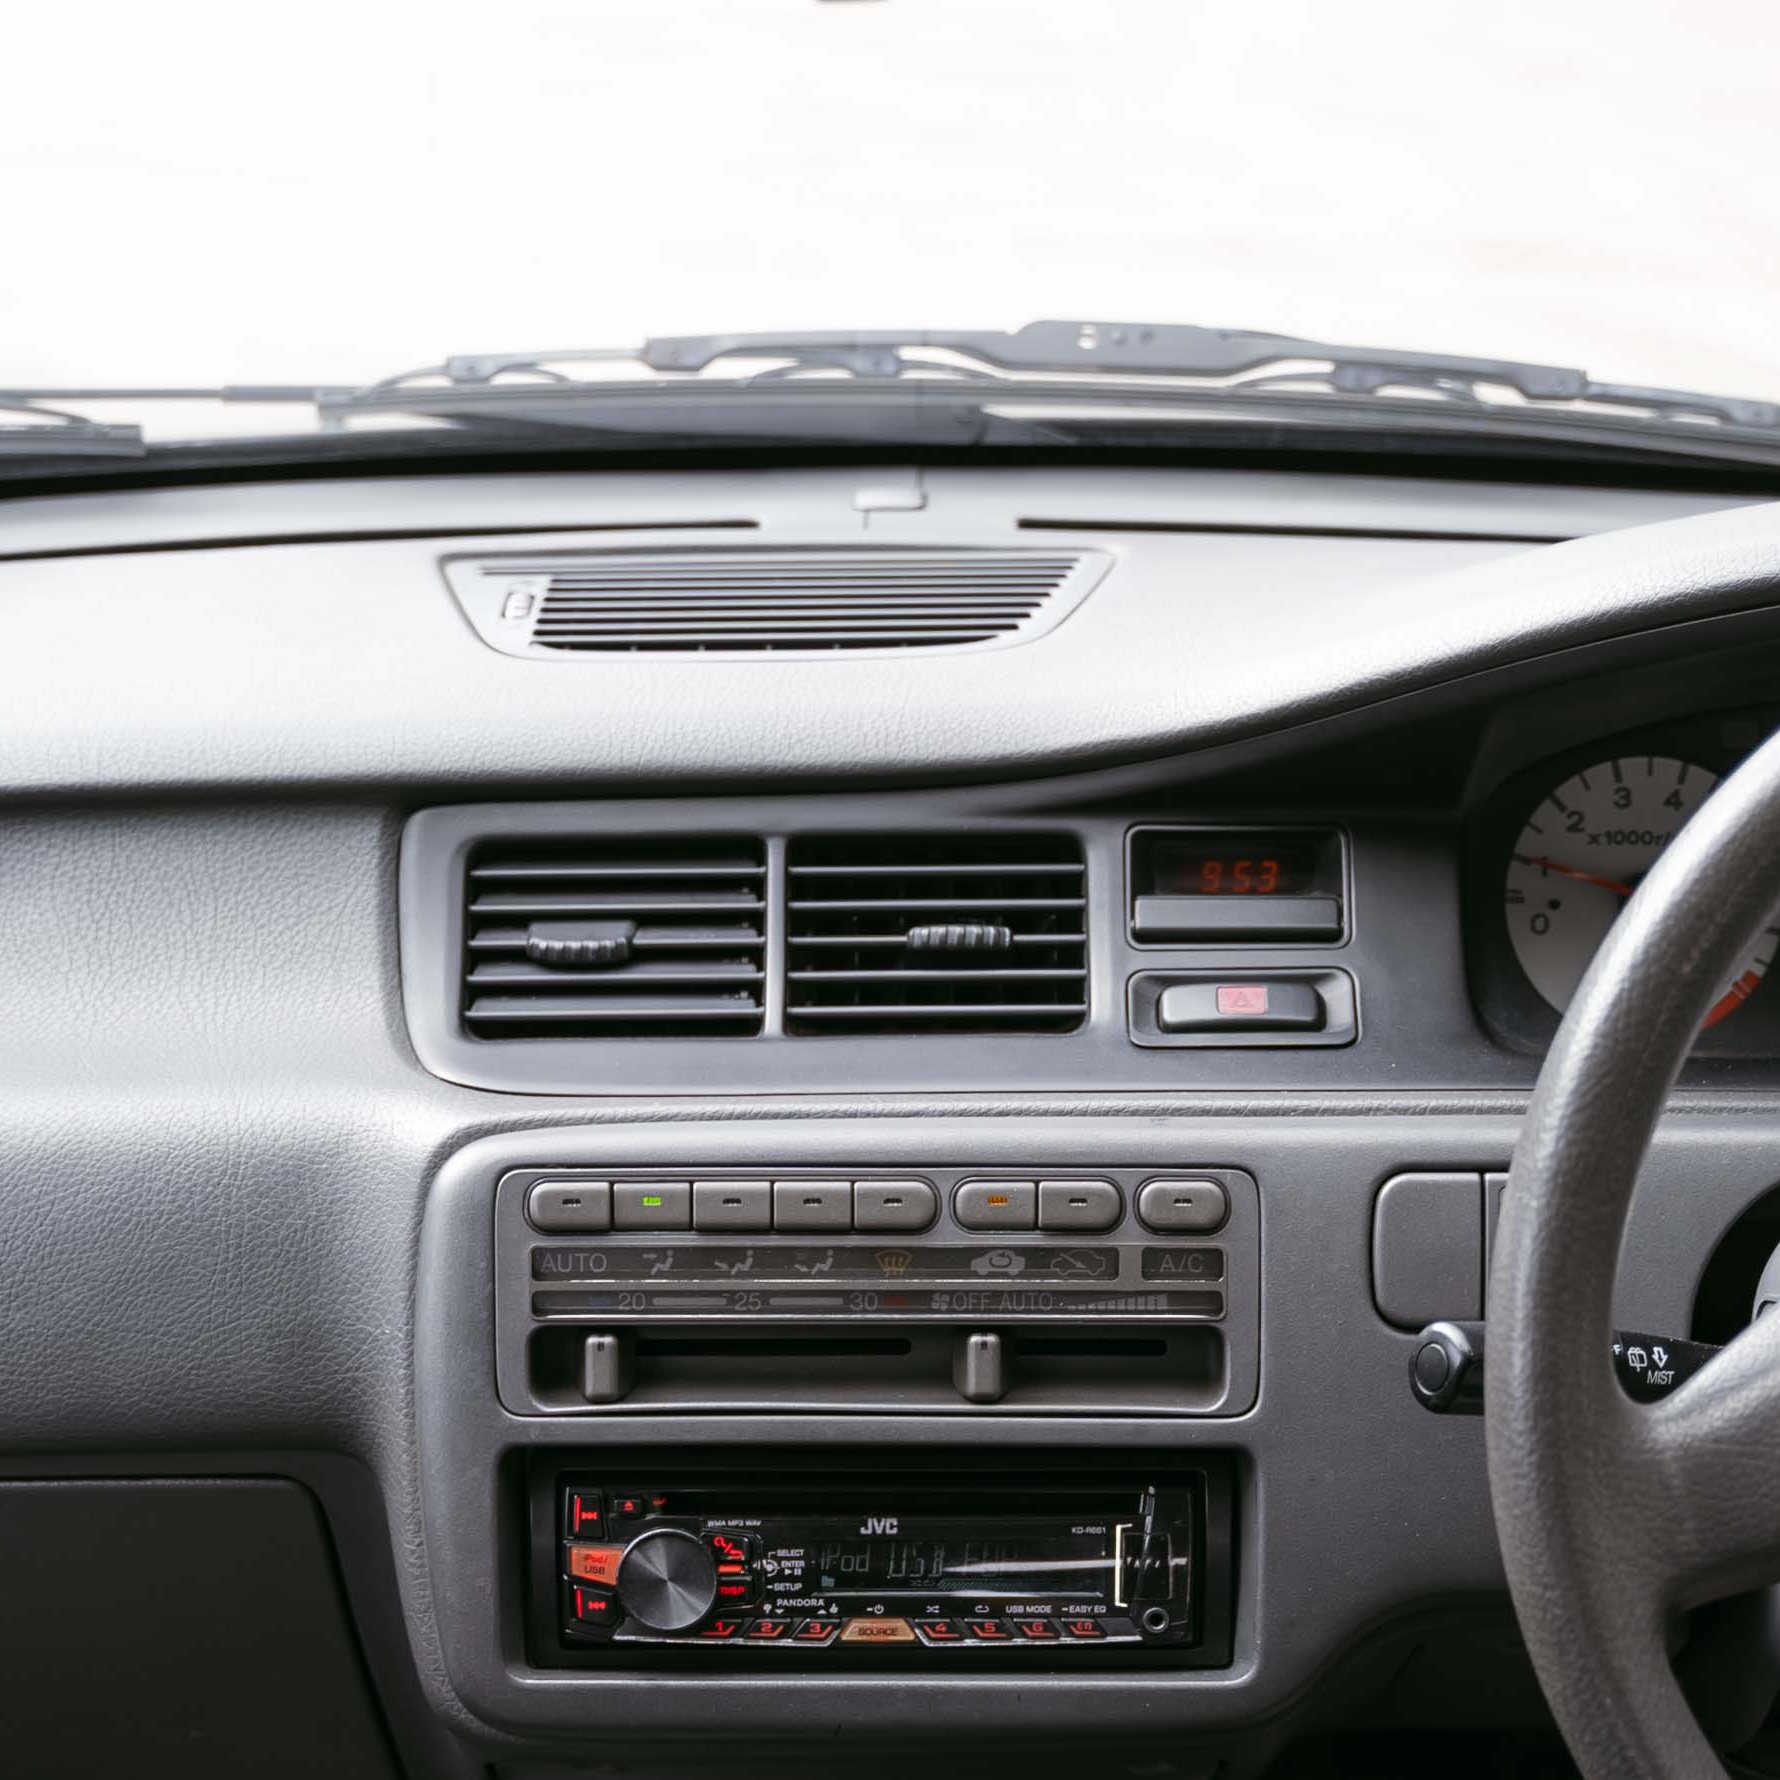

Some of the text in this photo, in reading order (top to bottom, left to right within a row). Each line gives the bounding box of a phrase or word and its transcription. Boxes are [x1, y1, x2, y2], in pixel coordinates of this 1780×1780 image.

[1613, 787, 1632, 808] 3
[1663, 789, 1683, 812] 4
[1565, 811, 1586, 833] 2
[1531, 914, 1549, 935] 0
[539, 1252, 608, 1273] AUTO
[1159, 1253, 1204, 1274] A/C
[618, 1293, 878, 1311] 20 25 30
[952, 1292, 1052, 1311] OFF AUTO
[1646, 1370, 1675, 1385] MIST
[707, 1519, 762, 1527] WMA MP3 WAV
[860, 1517, 898, 1535] JVC
[776, 1549, 805, 1557] SELECT
[583, 1554, 608, 1564] iPod/
[780, 1560, 805, 1568] ENTER
[584, 1565, 606, 1575] USB
[776, 1598, 825, 1607] PANDORA
[1005, 1605, 1052, 1614] USB MODE
[1093, 1605, 1106, 1614] EQ
[715, 1621, 724, 1632] 1
[761, 1622, 773, 1633] 2
[810, 1623, 821, 1633] 3
[858, 1626, 897, 1637] SOURCE
[935, 1623, 946, 1633] 4
[984, 1623, 996, 1633] 5
